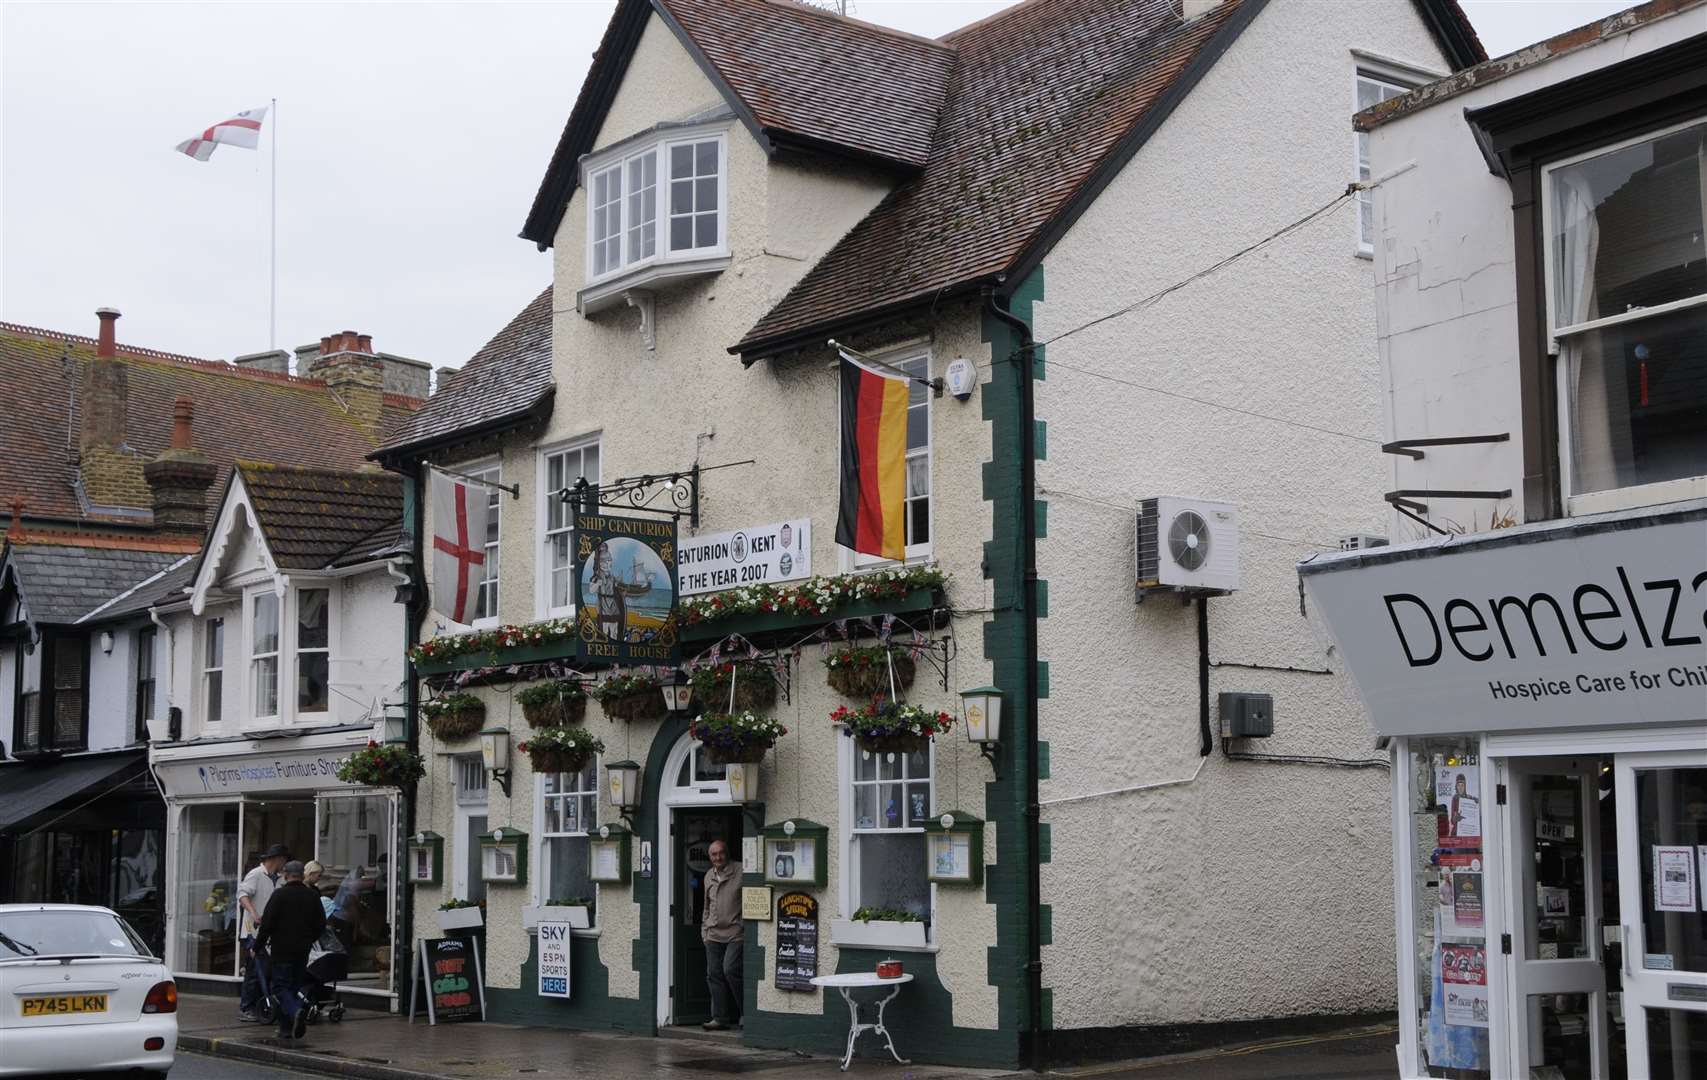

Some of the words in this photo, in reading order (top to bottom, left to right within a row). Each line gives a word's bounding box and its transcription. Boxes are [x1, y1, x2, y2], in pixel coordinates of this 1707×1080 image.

[578, 516, 606, 532] SHIP
[608, 518, 673, 537] CENTURION
[678, 542, 729, 565] ENTURION
[751, 535, 776, 554] KENT
[679, 576, 686, 591] F
[689, 572, 708, 589] THE
[710, 568, 738, 587] YEAR
[741, 563, 769, 583] 2007
[587, 643, 619, 657] FREE
[629, 645, 672, 659] HOUSE
[1488, 678, 1571, 702] Hospice
[1575, 673, 1627, 694] Care
[1629, 670, 1662, 690] for
[1667, 664, 1707, 688] Chi
[208, 765, 242, 786] Pilgrims
[241, 766, 277, 784] Hospices
[274, 761, 318, 778] Furniture
[1541, 823, 1562, 838] OPEN
[541, 925, 567, 940] SKY
[547, 943, 561, 951] AND
[543, 952, 566, 963] ESPN
[541, 964, 568, 976] SPORTS
[542, 977, 567, 993] HERE
[23, 998, 68, 1014] P745
[72, 996, 105, 1012] LKN
